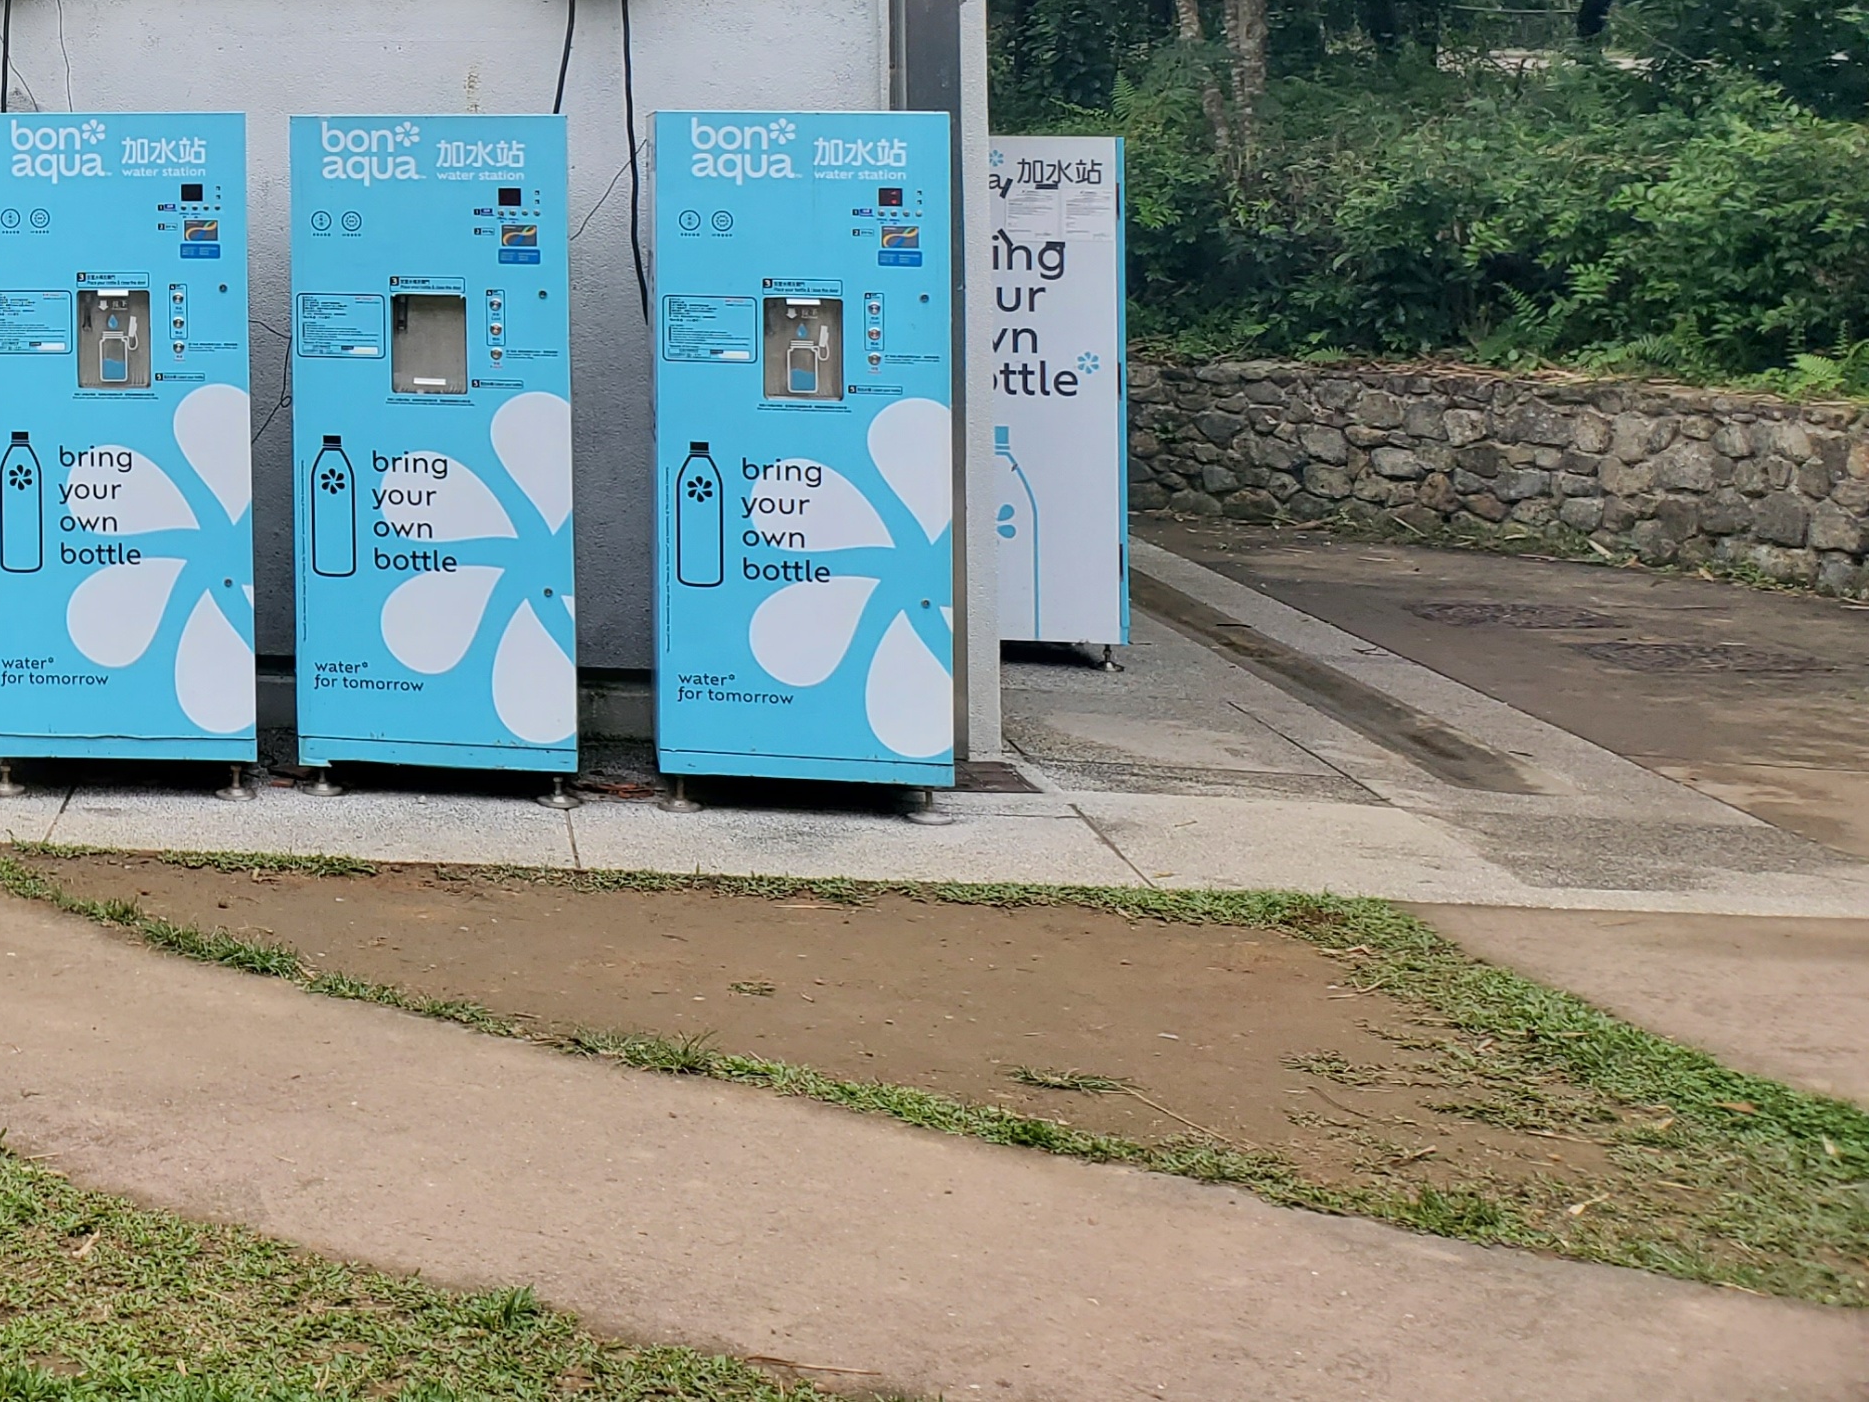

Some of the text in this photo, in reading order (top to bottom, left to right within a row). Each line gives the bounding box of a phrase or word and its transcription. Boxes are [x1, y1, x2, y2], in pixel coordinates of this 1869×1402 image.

[11, 119, 80, 150] bon
[322, 122, 394, 153] bon
[691, 117, 769, 150] bon
[122, 137, 206, 164] 加水站
[436, 140, 525, 169] 加水站
[814, 138, 907, 168] 加水站
[11, 152, 106, 184] aqua
[122, 167, 206, 177] water station
[322, 155, 418, 186] aqua
[436, 170, 524, 180] water station
[691, 152, 795, 185] aqua
[814, 170, 906, 180] water station
[1017, 158, 1103, 184] 加水站
[992, 234, 1065, 280] ing
[996, 286, 1046, 312] ur
[993, 360, 1078, 396] ttle
[59, 445, 133, 473] bring
[372, 450, 448, 479] bring
[742, 457, 822, 488] bring
[58, 482, 122, 505] your
[372, 487, 437, 510] your
[741, 496, 810, 518] your
[60, 514, 118, 532] own
[373, 520, 433, 539] own
[742, 529, 805, 548] own
[60, 542, 142, 566] bottle
[374, 548, 458, 573] bottle
[742, 558, 830, 583] bottle
[2, 658, 47, 670] water
[314, 662, 361, 674] water
[1, 672, 109, 687] for tomorrow
[314, 675, 424, 691] for tomorrow
[678, 673, 729, 686] water
[678, 688, 794, 705] for tomorrow
